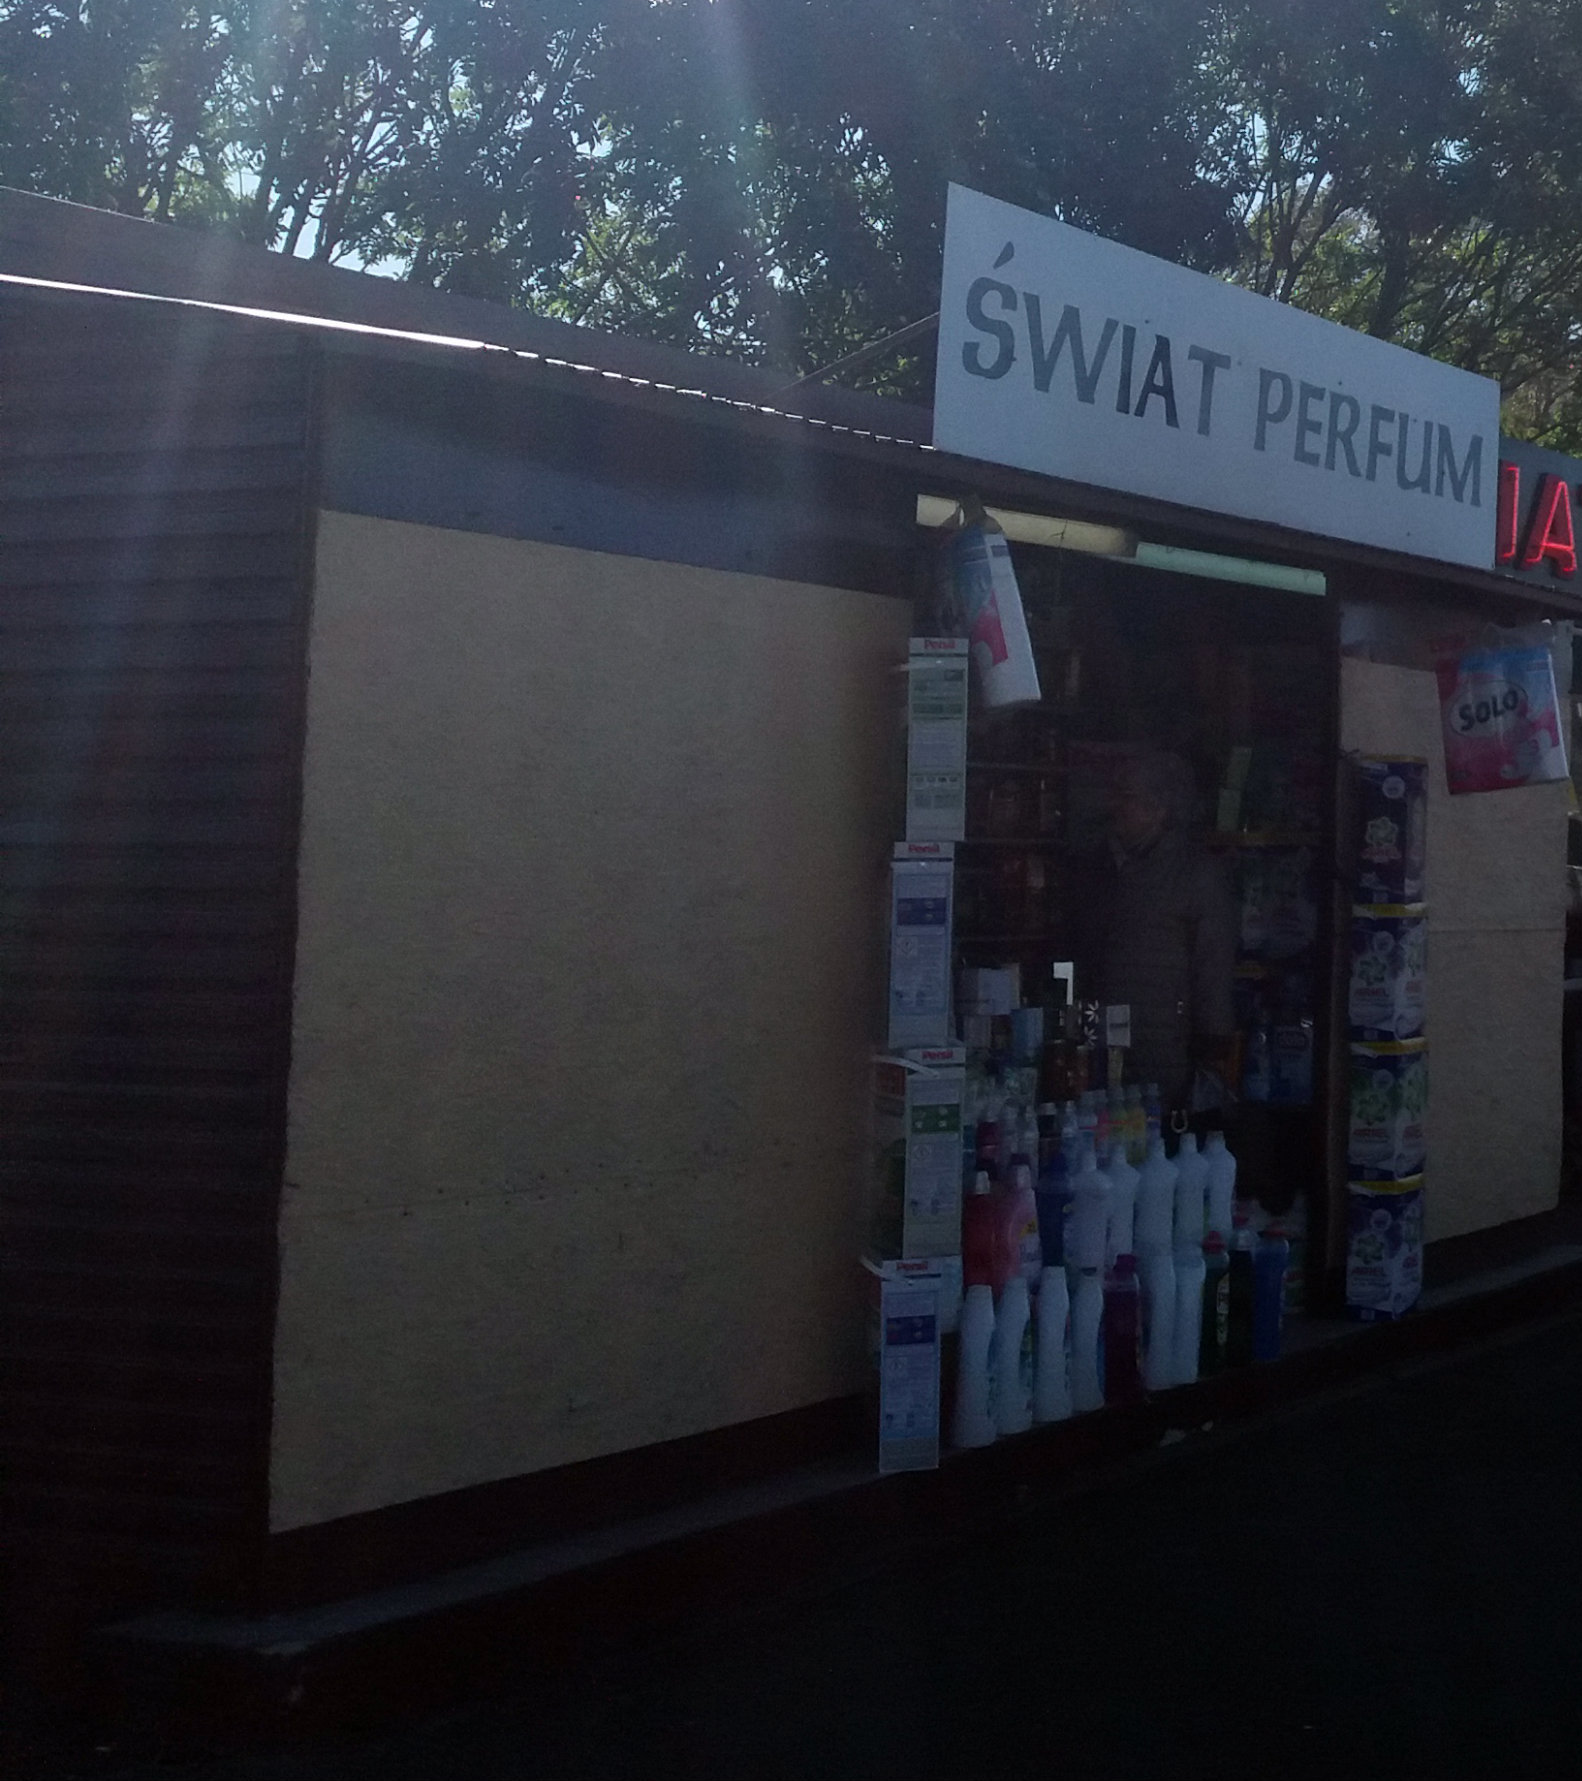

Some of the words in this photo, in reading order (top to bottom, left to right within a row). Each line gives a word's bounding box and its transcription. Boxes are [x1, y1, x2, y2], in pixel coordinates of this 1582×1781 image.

[961, 241, 1231, 436] ŚWIAT
[1253, 368, 1485, 508] PERFUM
[1458, 688, 1519, 731] SOLO
